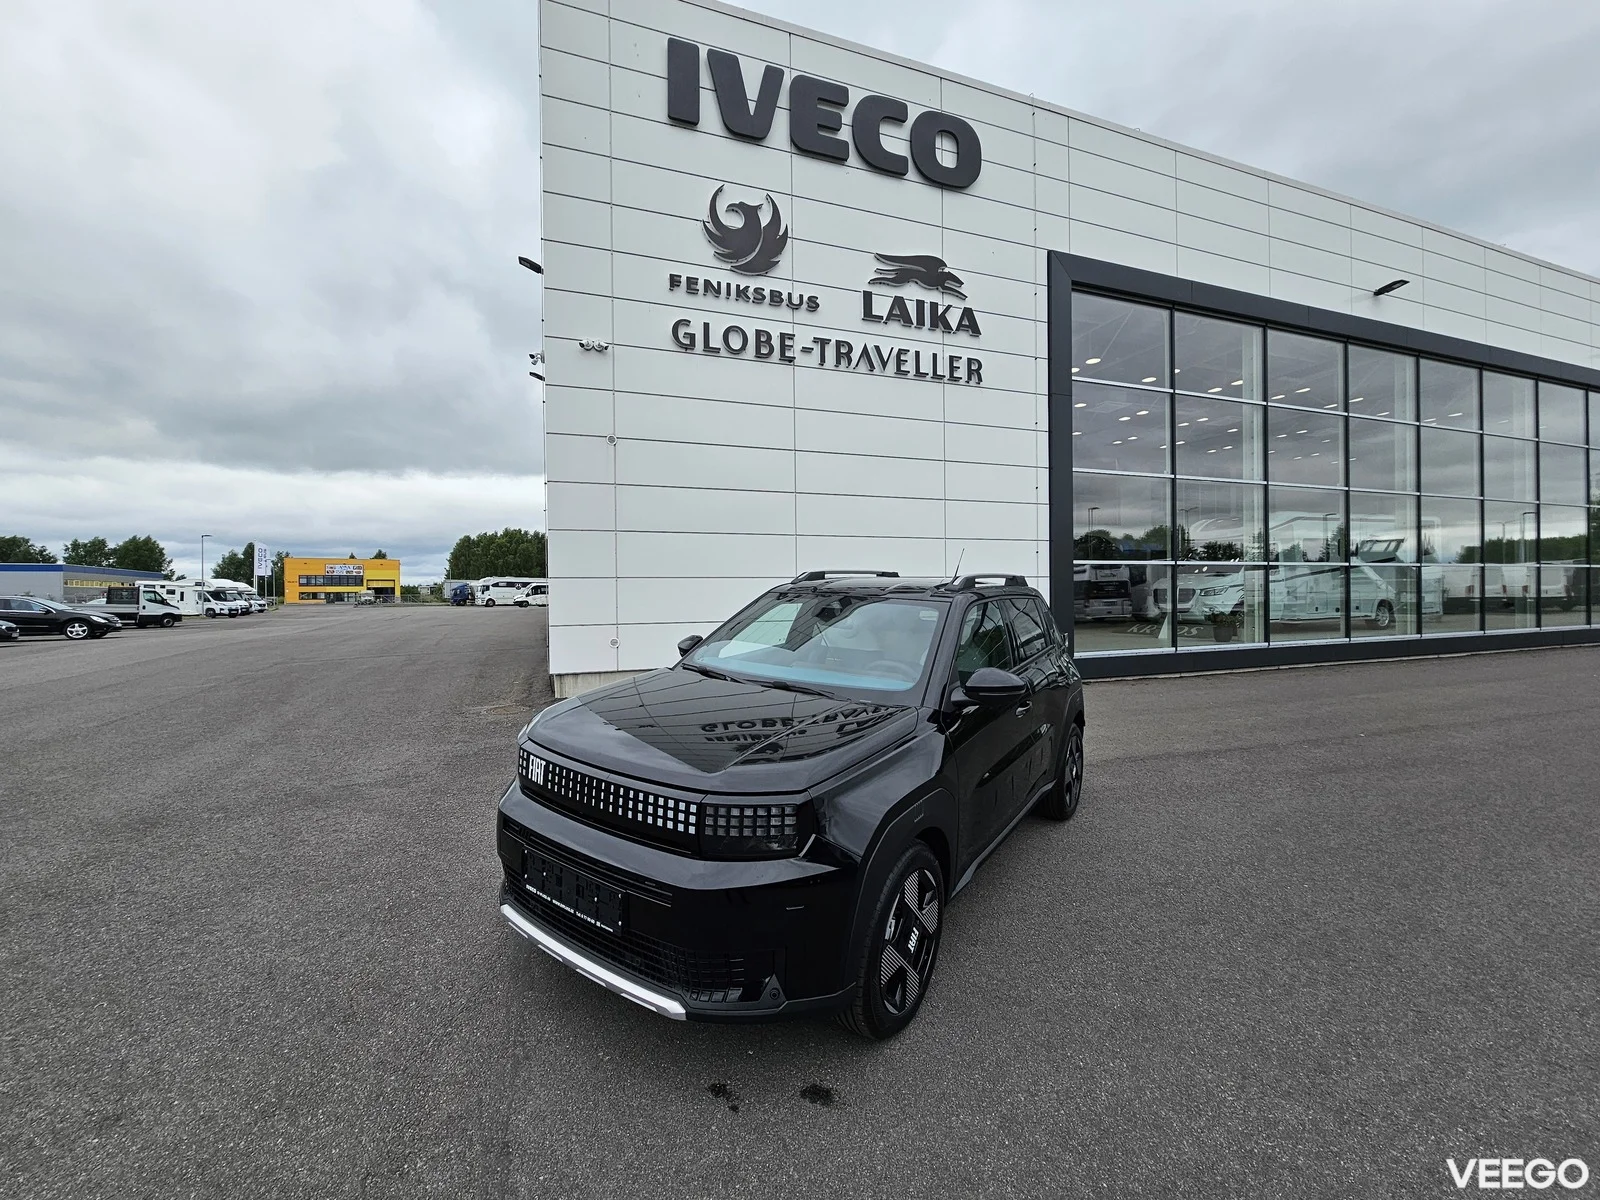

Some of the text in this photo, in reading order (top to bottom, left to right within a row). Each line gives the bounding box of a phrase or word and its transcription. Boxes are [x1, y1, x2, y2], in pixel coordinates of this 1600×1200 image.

[667, 37, 982, 188] IVECO
[669, 273, 820, 312] FENIKSBUS
[862, 290, 982, 337] LAIKA
[671, 318, 983, 384] GLOBE-TRAVELLER
[1127, 623, 1204, 636] KROS
[528, 754, 546, 786] FIAT
[907, 926, 919, 954] FIAT
